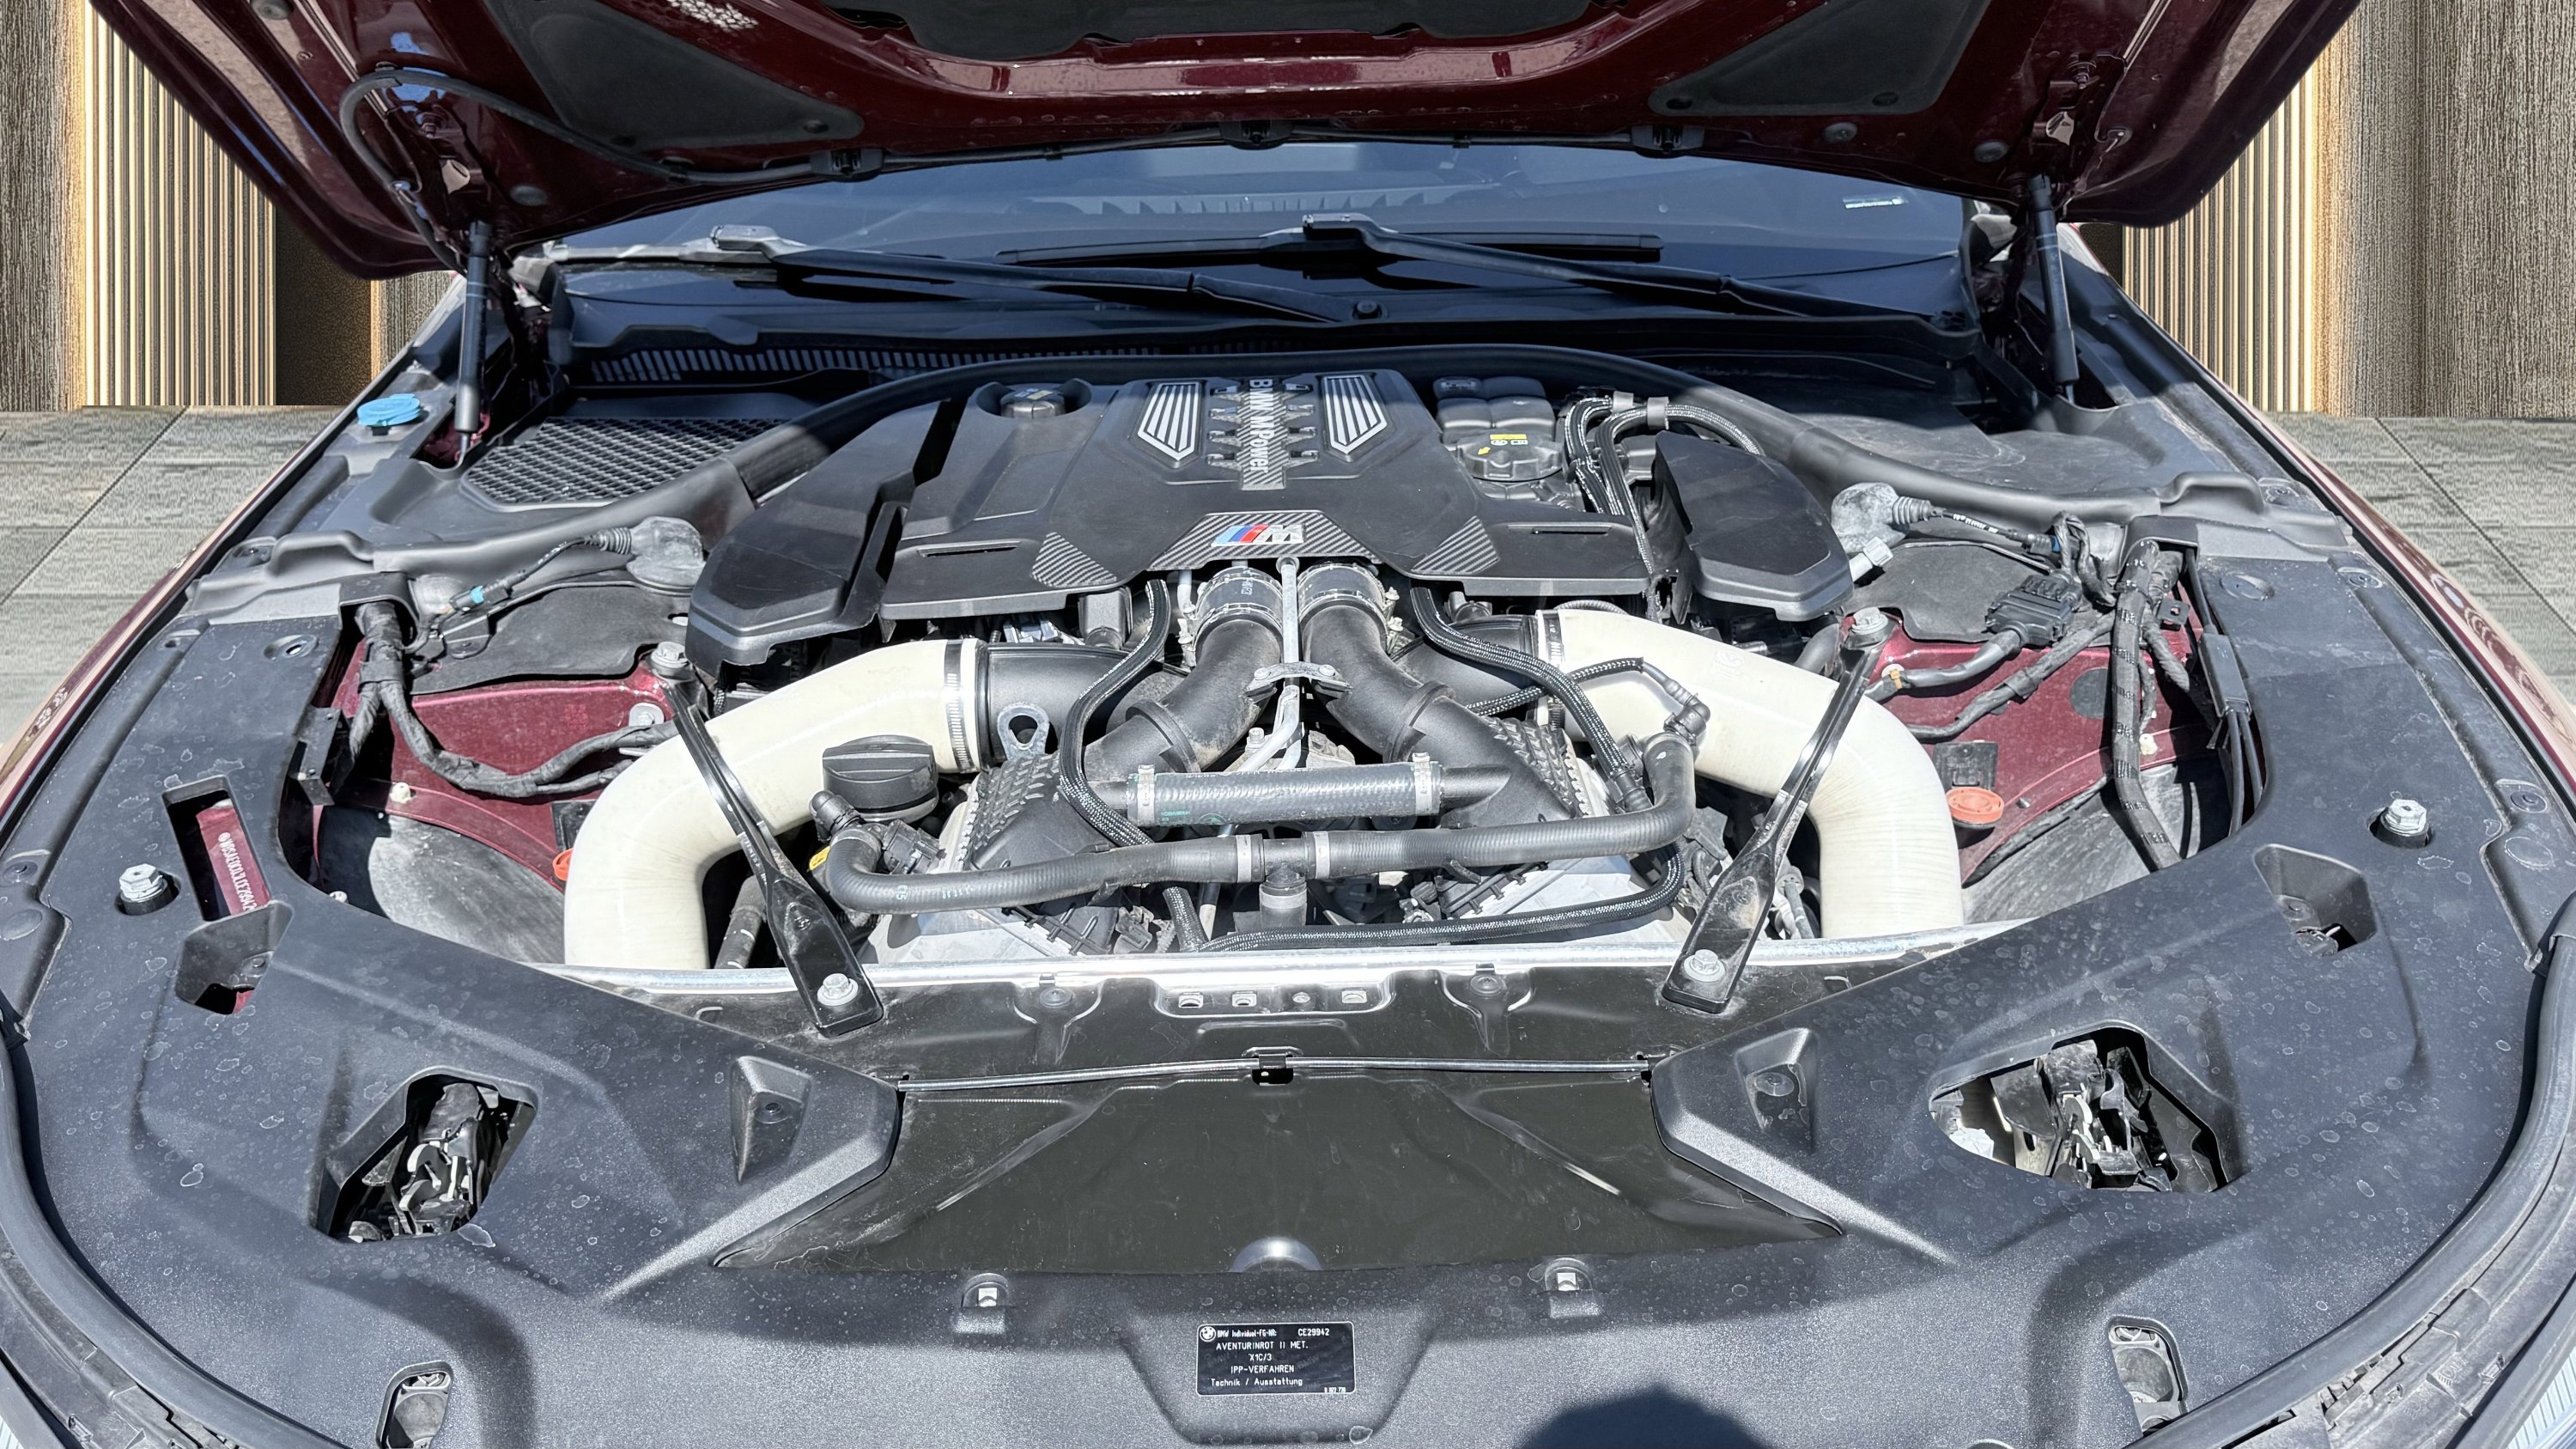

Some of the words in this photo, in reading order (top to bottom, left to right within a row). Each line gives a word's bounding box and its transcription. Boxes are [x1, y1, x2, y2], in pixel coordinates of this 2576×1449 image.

[1249, 378, 1273, 411] BMW
[1217, 1330, 1230, 1338] BMW
[1297, 1328, 1330, 1336] CE29942
[1216, 1341, 1274, 1350] AVENTURINROT
[1290, 1341, 1309, 1349] MET.
[1230, 1365, 1295, 1374] IPP-VERFAHREN
[1211, 1379, 1241, 1387] Technik
[1254, 1378, 1303, 1387] Ausstattung
